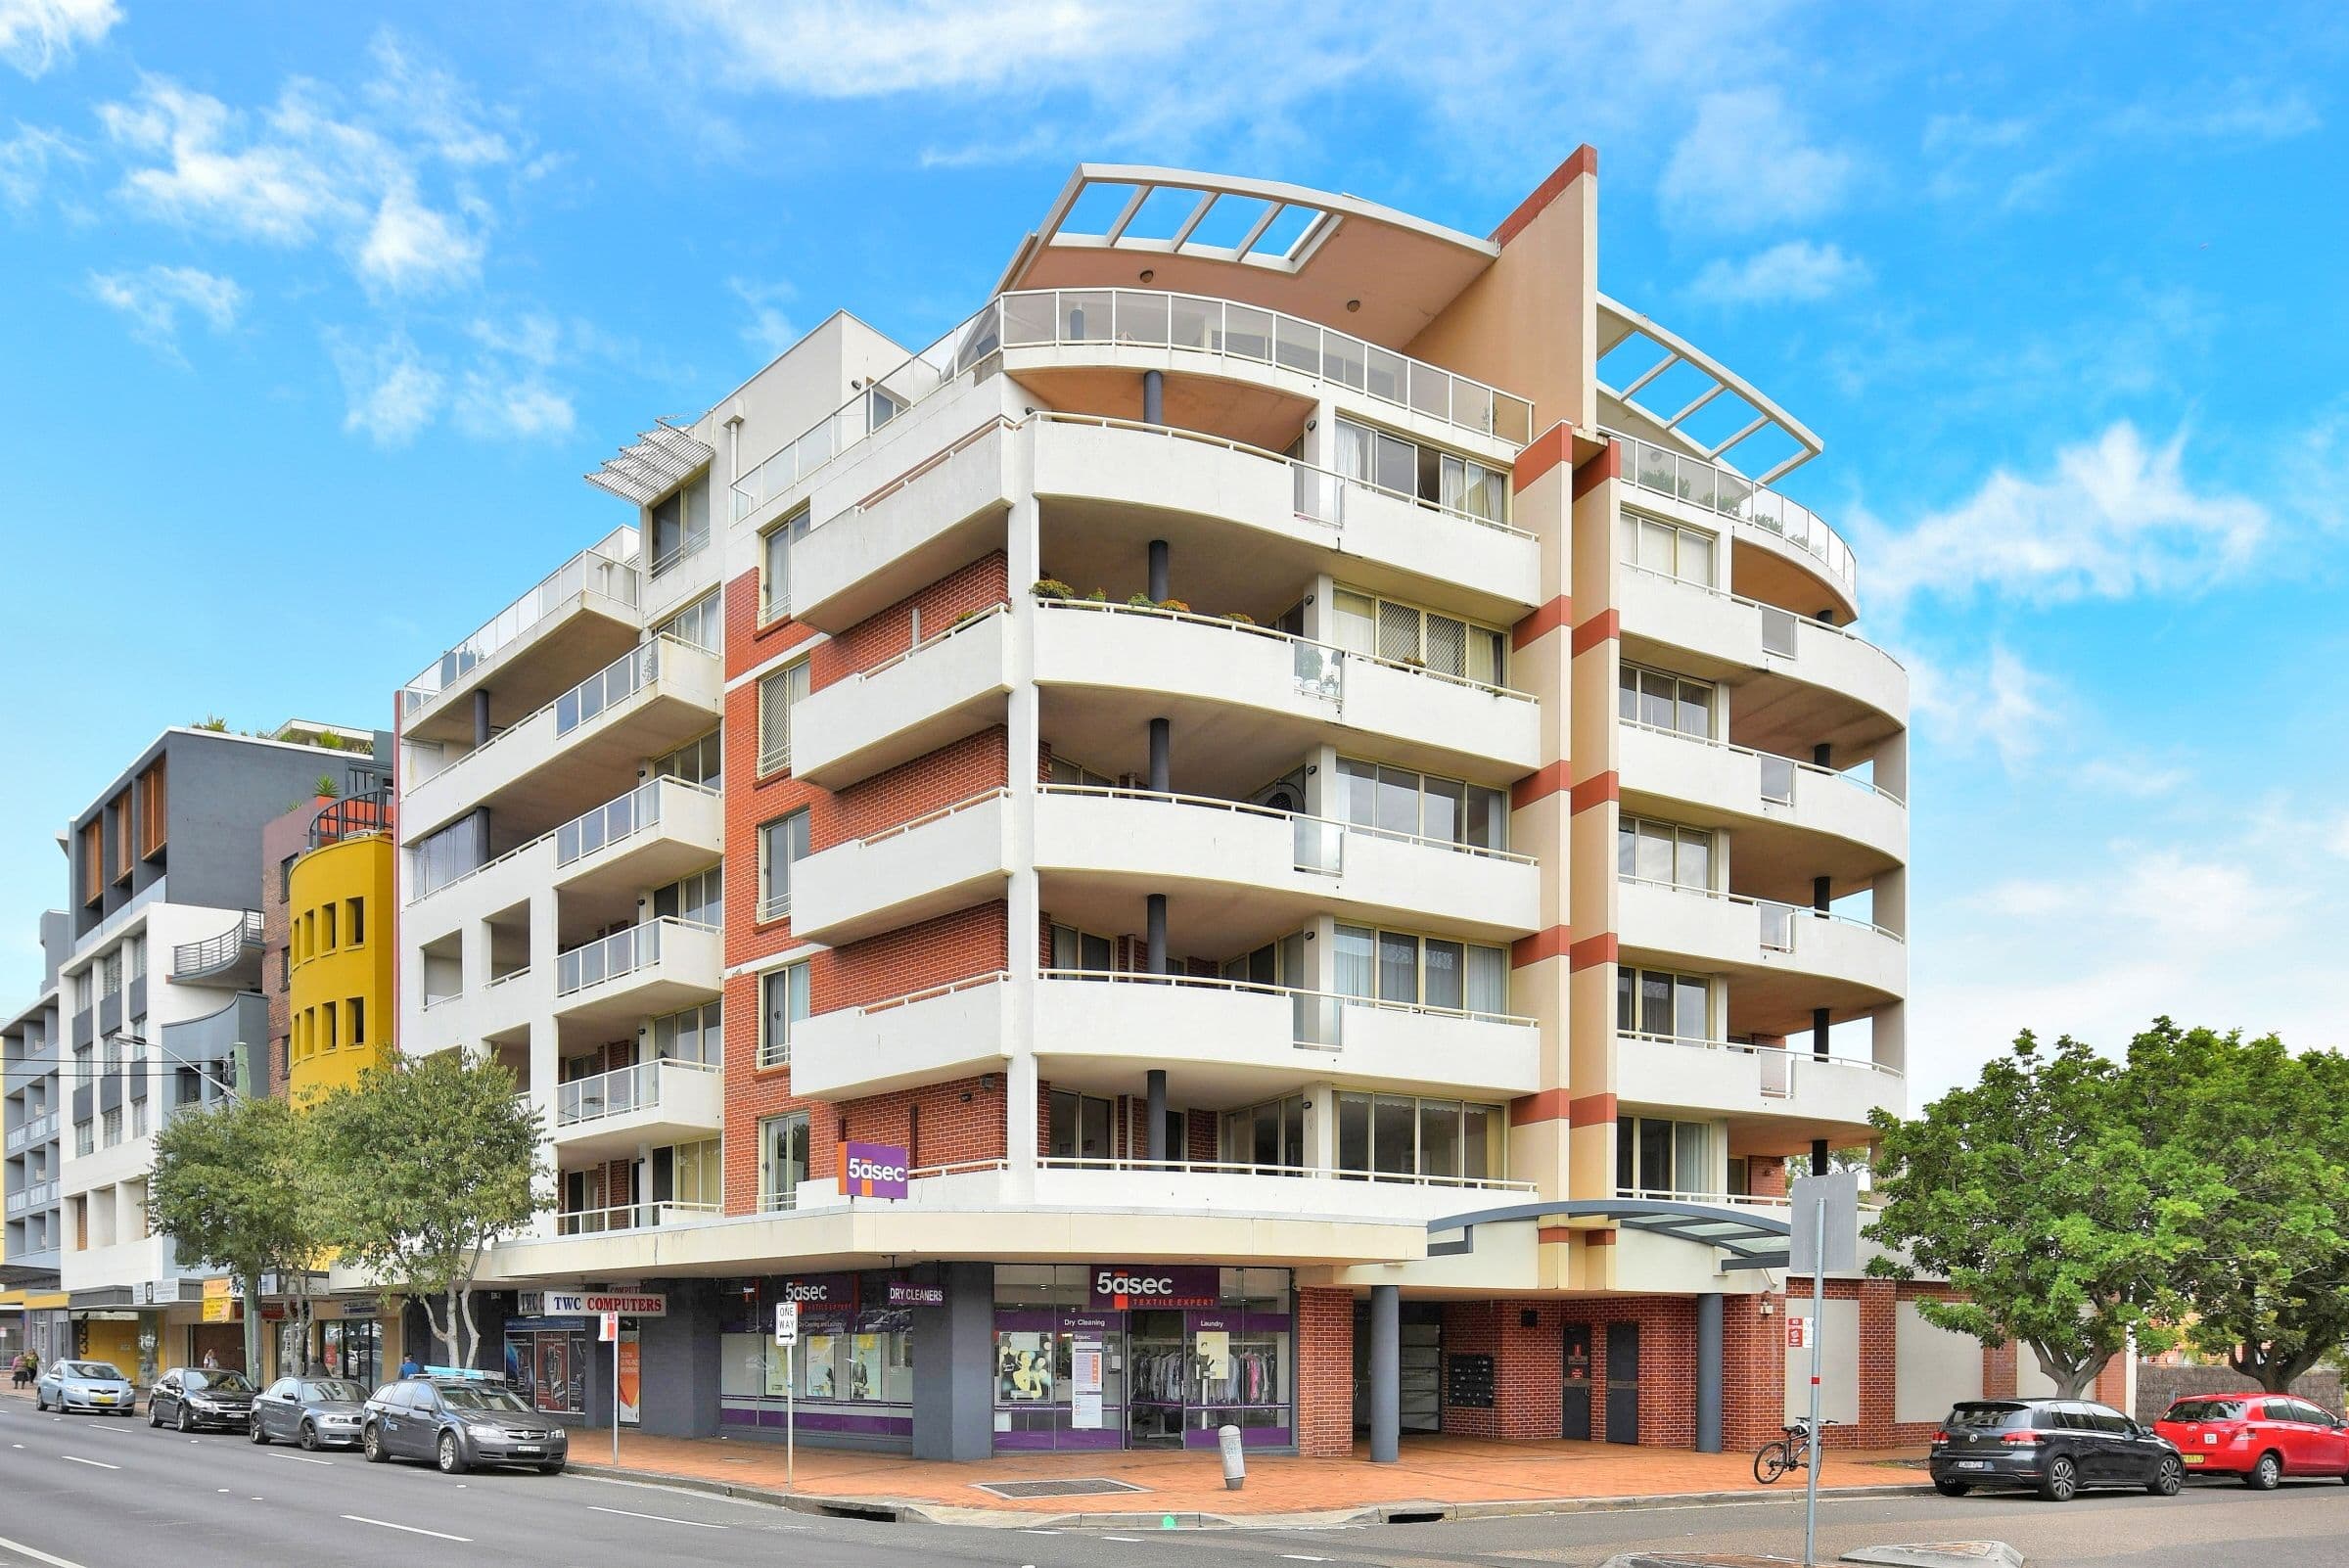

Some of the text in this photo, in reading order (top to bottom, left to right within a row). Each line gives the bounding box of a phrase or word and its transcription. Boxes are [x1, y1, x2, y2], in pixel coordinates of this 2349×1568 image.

[890, 1287, 944, 1302] DRY CLEANERS
[553, 1296, 581, 1311] TWC
[587, 1297, 662, 1312] COMPUTERS
[1132, 1298, 1215, 1307] TEXTILE EXPERT
[779, 1306, 795, 1317] ONE
[779, 1318, 795, 1330] WAY
[1064, 1318, 1105, 1327] Dry Cleaning
[1200, 1319, 1223, 1329] Laundry
